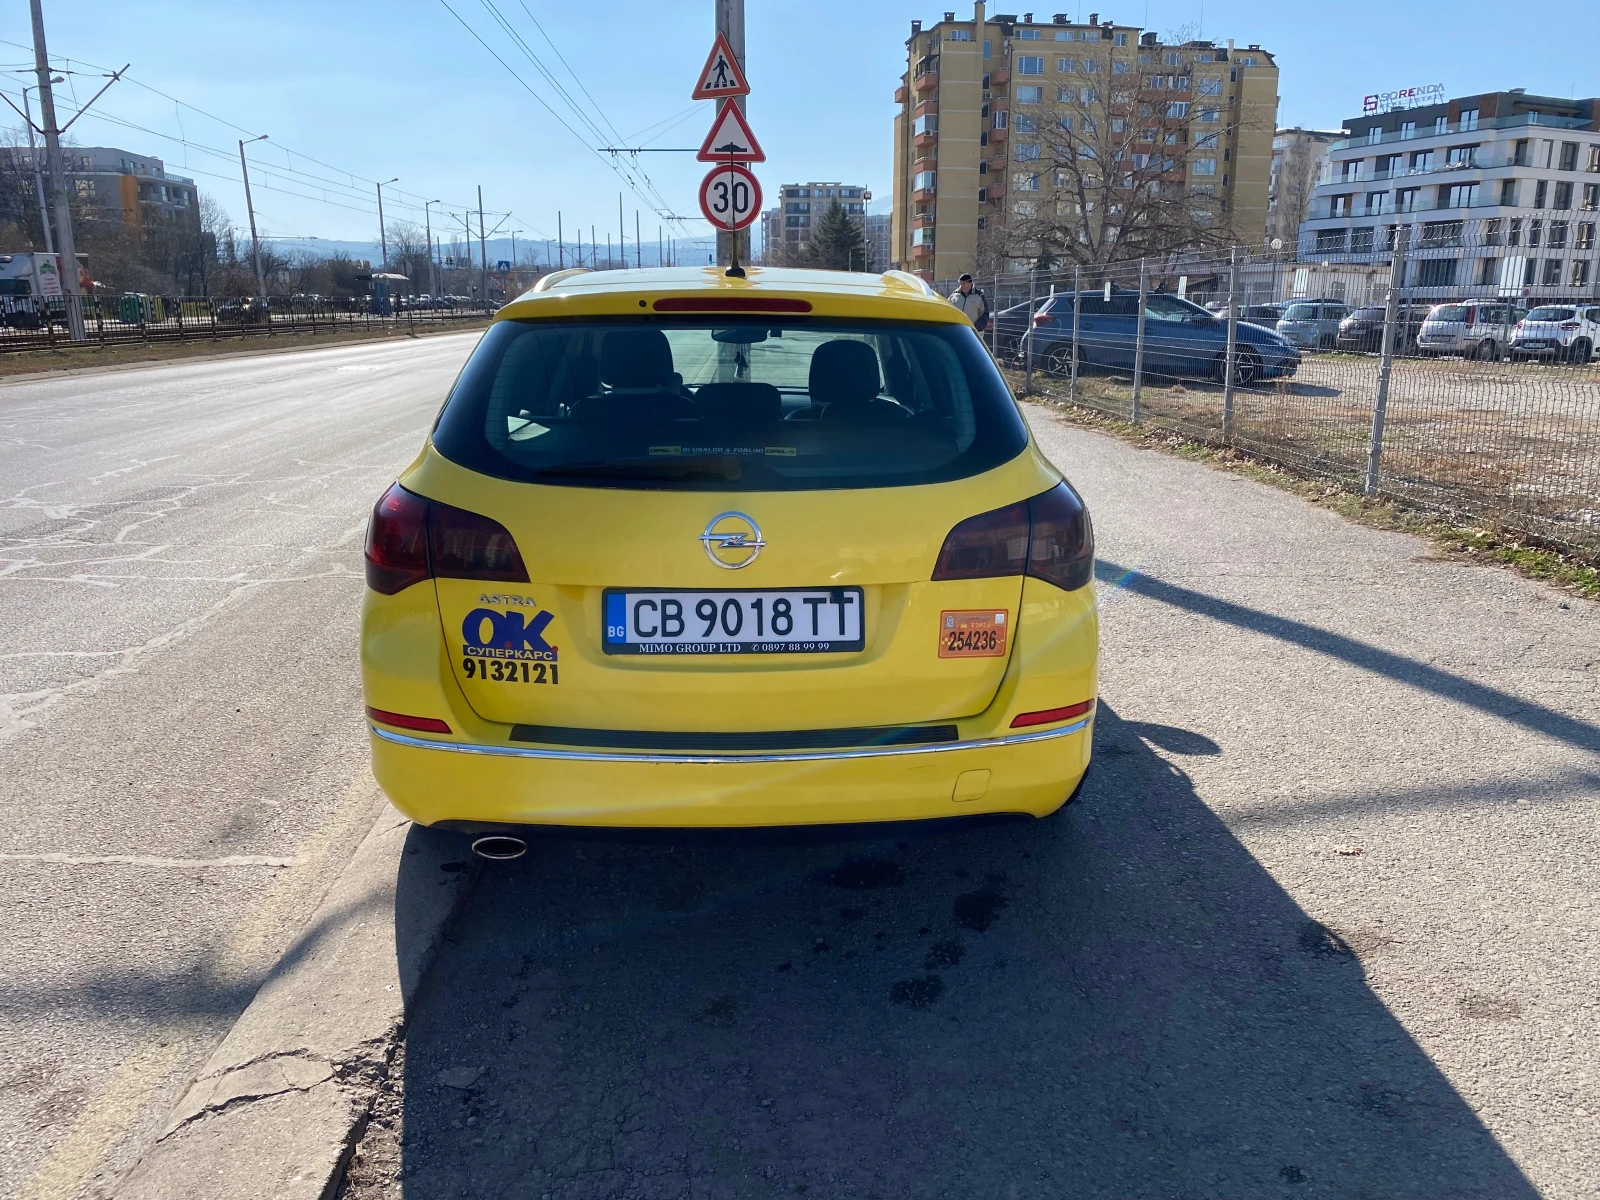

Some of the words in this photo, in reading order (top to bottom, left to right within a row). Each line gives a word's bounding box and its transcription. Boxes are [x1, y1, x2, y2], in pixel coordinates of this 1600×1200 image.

[1380, 83, 1445, 102] SORENDA
[713, 181, 749, 213] 30
[477, 593, 537, 608] ASTRA
[633, 598, 685, 638] CB
[695, 598, 794, 637] 9018
[802, 597, 854, 636] TT
[607, 625, 625, 637] BG
[948, 630, 997, 651] 254236
[467, 646, 553, 661] СУПЕРКАРС
[639, 643, 673, 653] MIMO
[676, 643, 716, 653] GROUP
[719, 643, 741, 653] LTD
[762, 642, 785, 651] 0897
[788, 642, 801, 651] 88
[803, 642, 816, 651] 99
[817, 642, 830, 651] 99
[462, 657, 559, 685] 9132121
